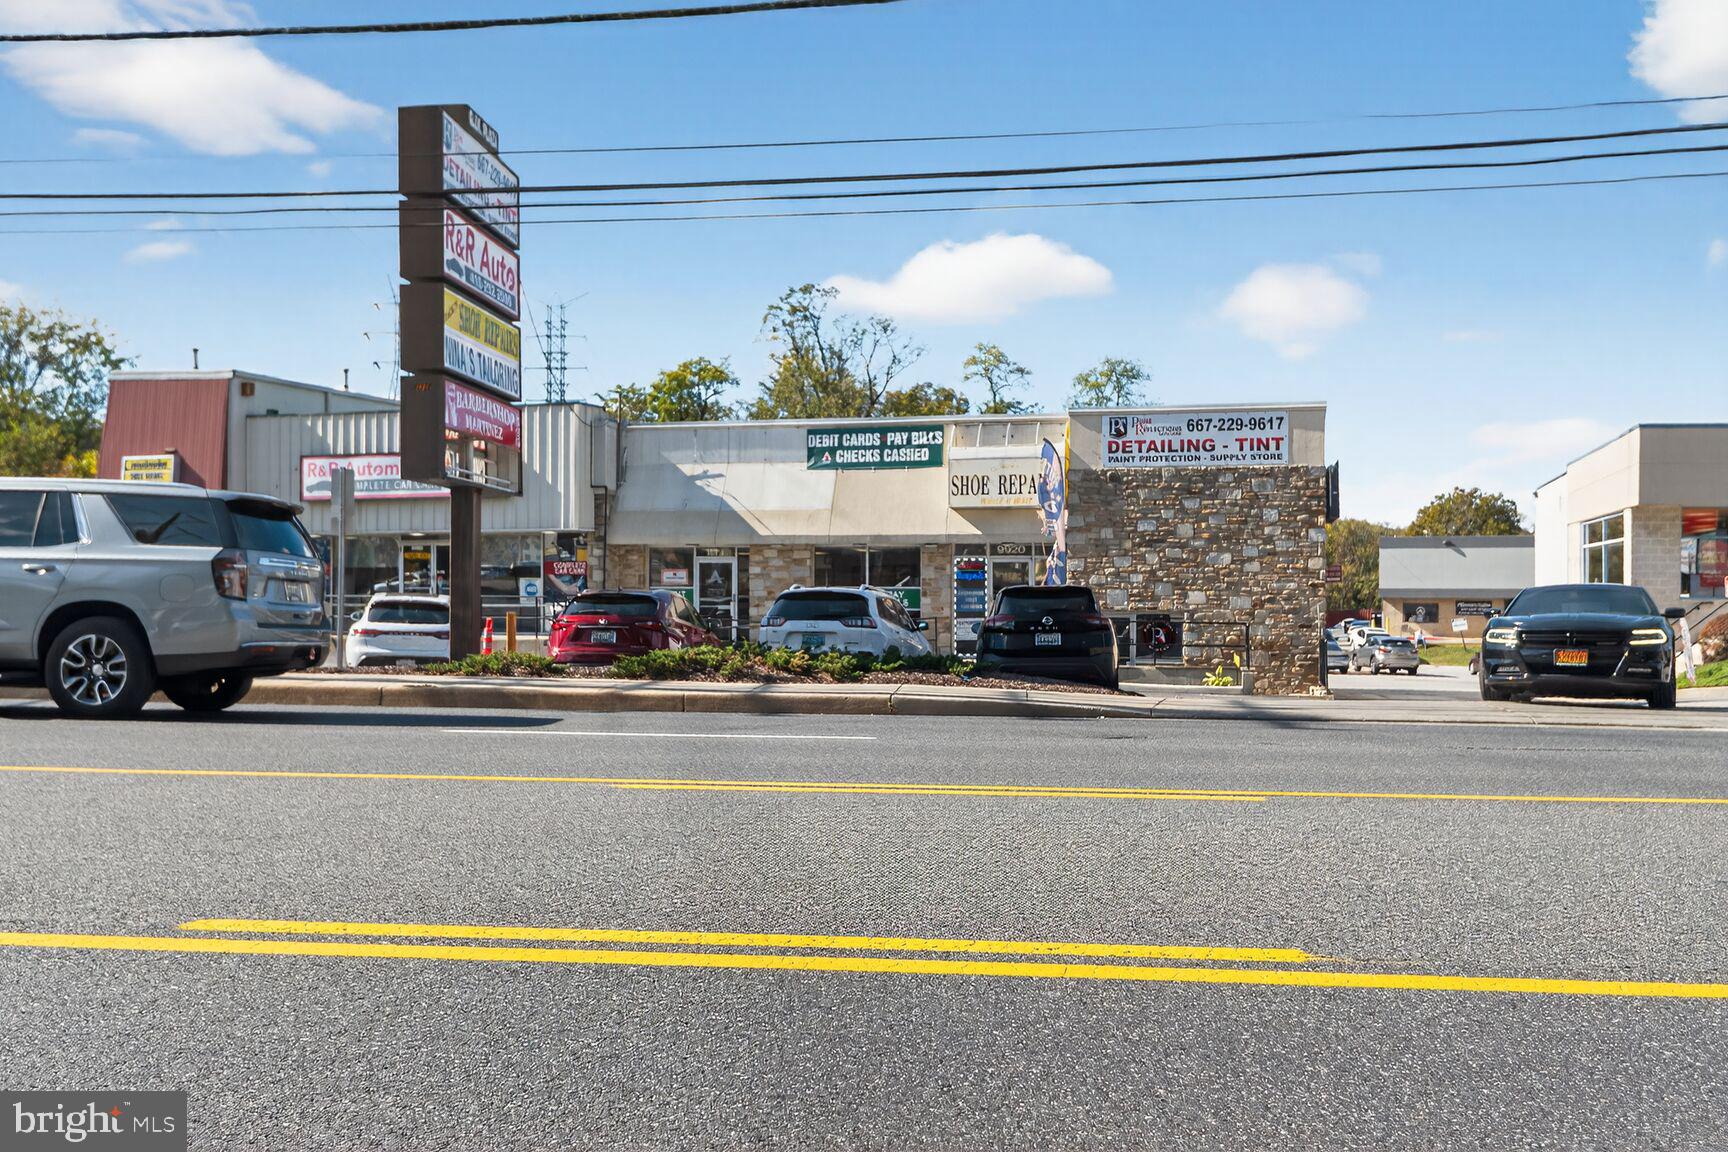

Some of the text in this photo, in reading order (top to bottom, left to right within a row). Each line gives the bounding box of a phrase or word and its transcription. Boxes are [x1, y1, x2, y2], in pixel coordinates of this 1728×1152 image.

[446, 211, 515, 292] R&R Auto
[445, 335, 519, 395] NINA'S TAILORING
[456, 390, 515, 431] BARBERSHOP
[1186, 416, 1284, 432] 667-229-9617
[808, 430, 943, 448] DEBIT CARDS PAY BILLS
[1107, 438, 1216, 454] DETAILING
[1235, 437, 1284, 451] TINT
[835, 447, 929, 463] CHECKS CASHED
[1108, 455, 1135, 463] PAINT
[1139, 455, 1201, 463] PROTECTION
[1210, 454, 1247, 462] SUPPLY
[1250, 453, 1283, 461] STORE
[356, 480, 393, 491] MPLETE
[951, 473, 1039, 496] SHOE REPA
